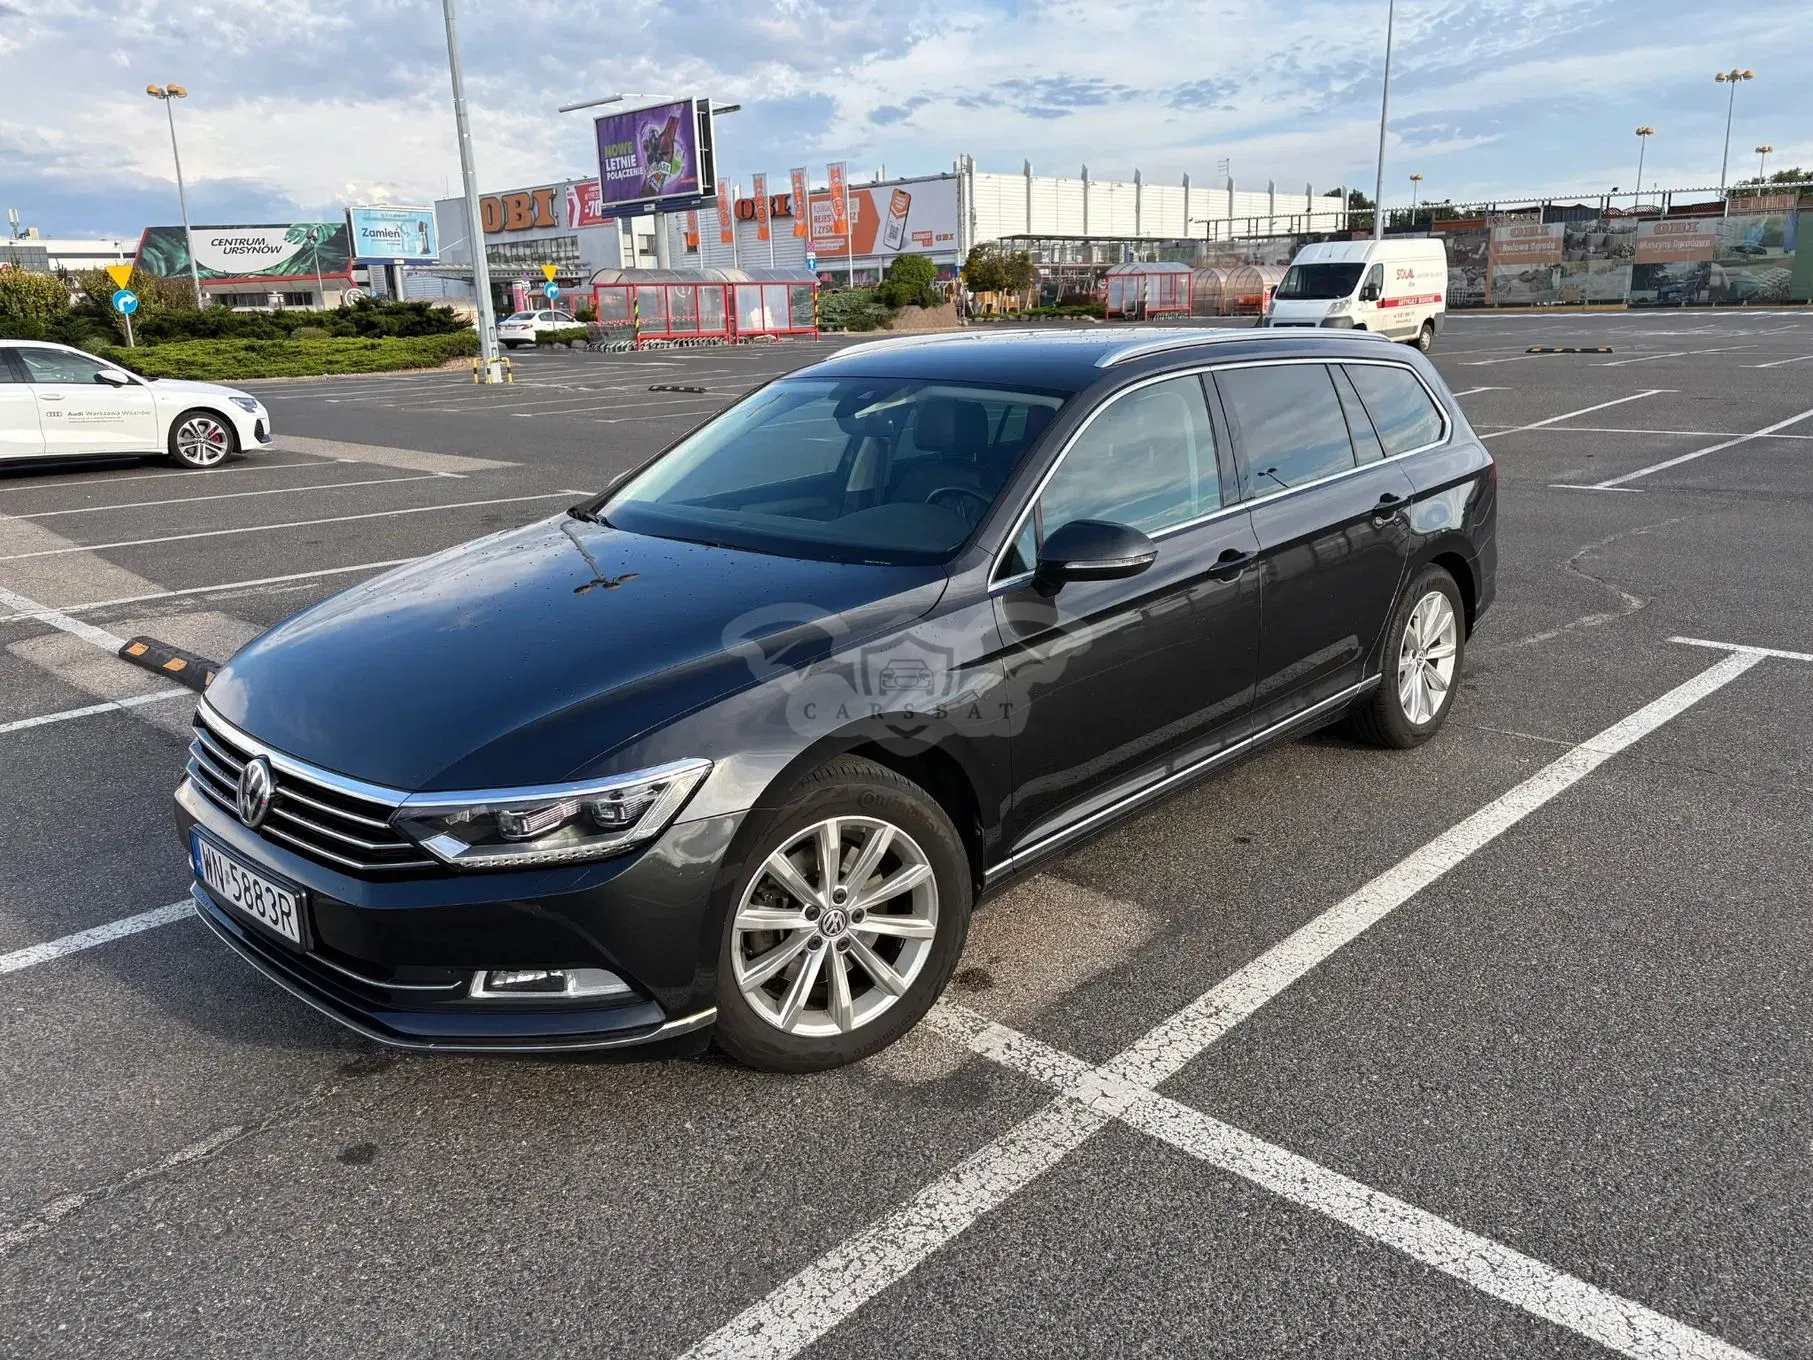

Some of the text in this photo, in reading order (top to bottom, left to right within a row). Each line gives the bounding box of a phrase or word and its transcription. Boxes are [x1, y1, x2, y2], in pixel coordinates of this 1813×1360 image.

[604, 141, 633, 158] NOWE
[605, 154, 637, 171] LETNIE
[606, 166, 644, 181] POŁĄCZENIE
[480, 188, 558, 233] OBI
[362, 228, 400, 238] Zamień
[1510, 226, 1550, 238] OBI
[1654, 222, 1699, 234] OBI
[211, 238, 265, 247] CENTRUM
[223, 244, 282, 254] URSYNÓW
[201, 843, 295, 937] WN 5883R
